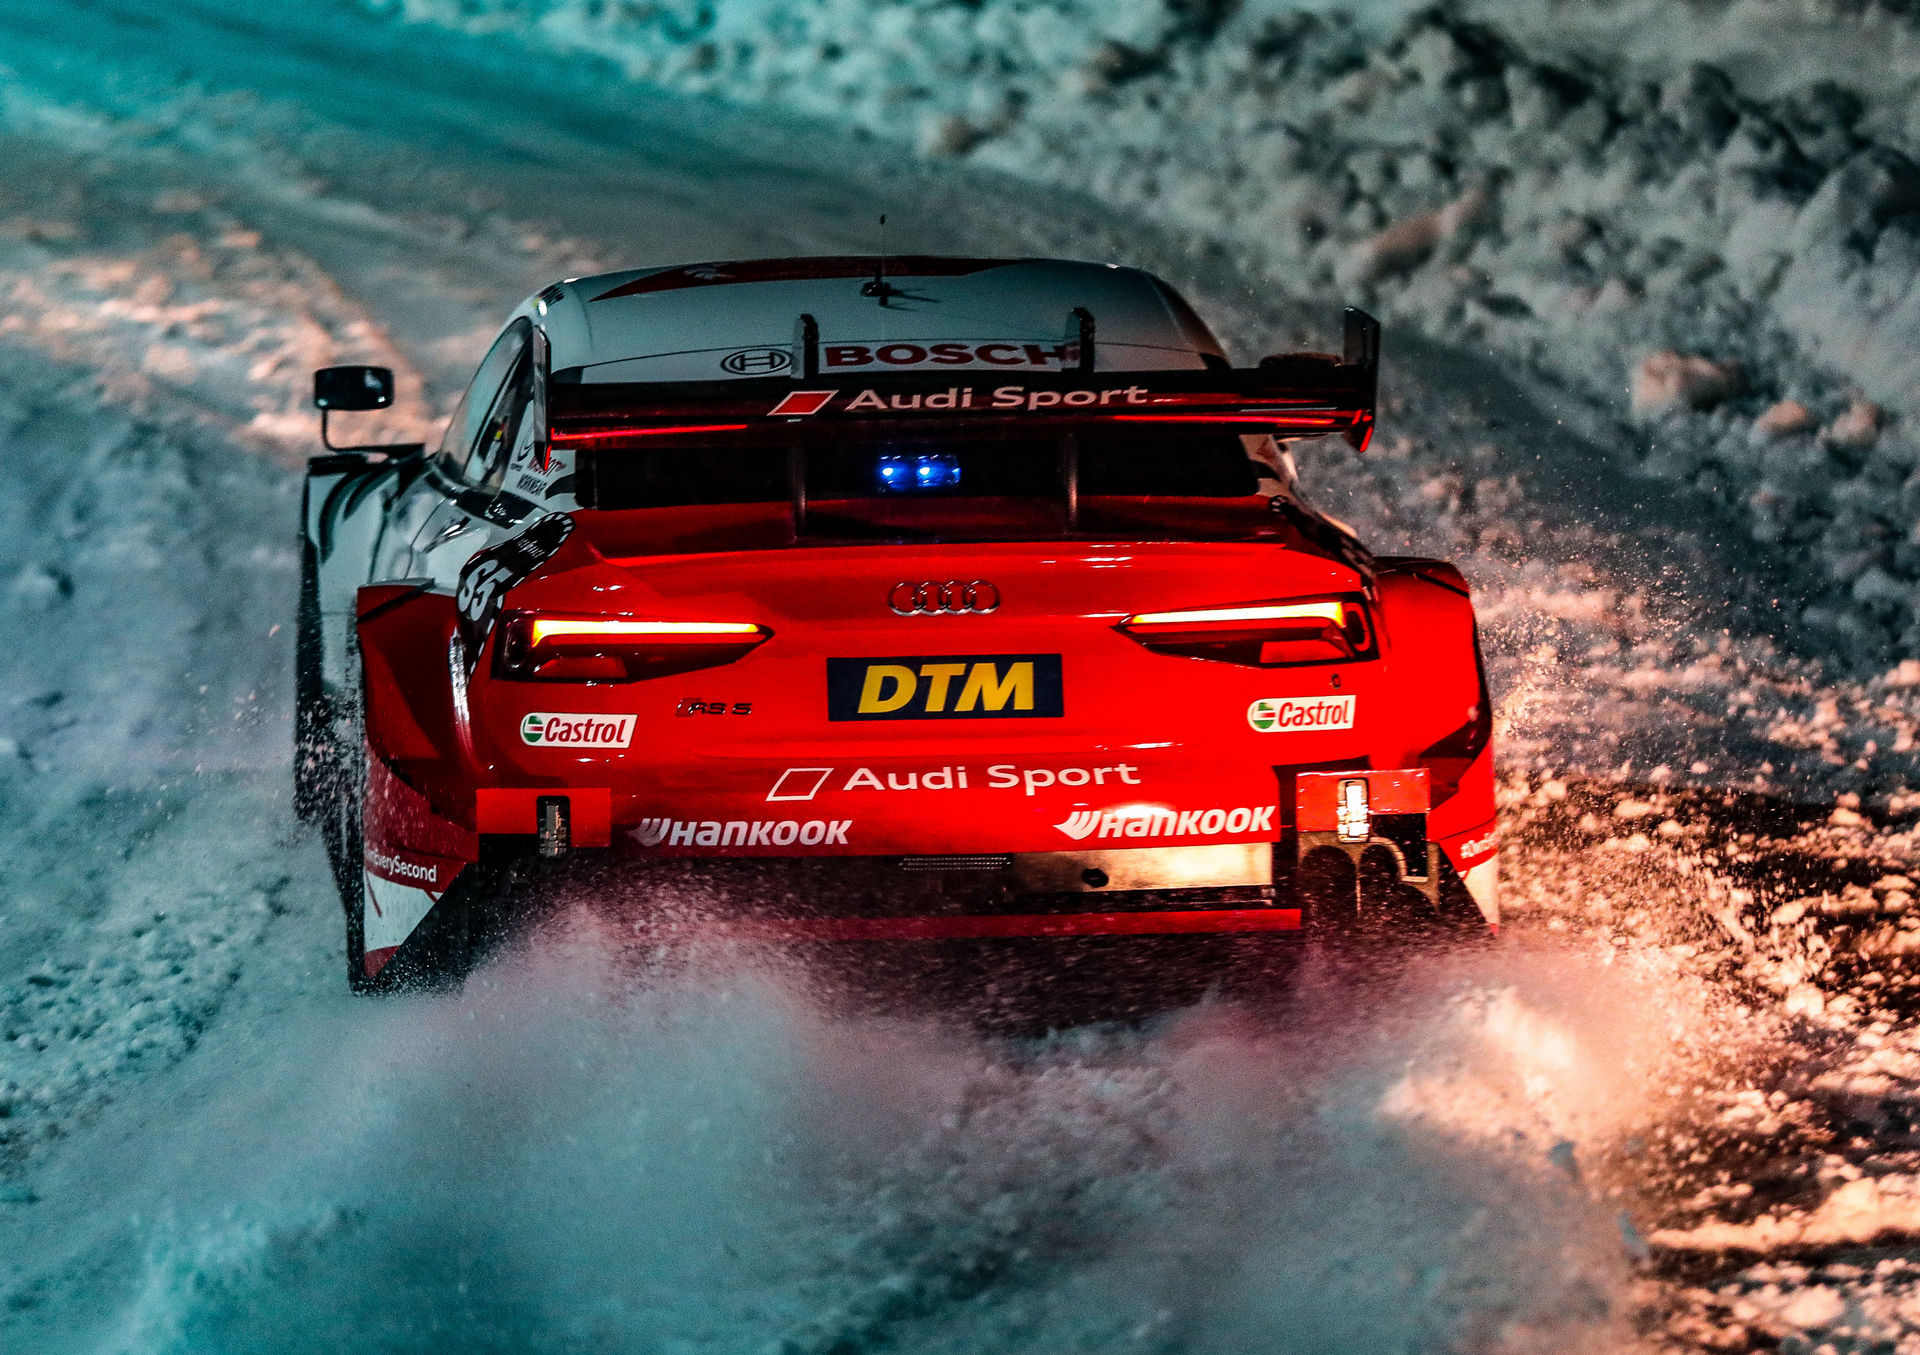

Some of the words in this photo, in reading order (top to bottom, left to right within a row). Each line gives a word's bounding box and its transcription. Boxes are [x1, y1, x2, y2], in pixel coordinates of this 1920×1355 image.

[825, 344, 1068, 368] BOSCH
[845, 388, 973, 411] Audi
[991, 385, 1149, 411] Sport
[857, 662, 1034, 713] DTM
[732, 703, 752, 715] 5
[1278, 701, 1350, 727] Castrol
[545, 717, 627, 743] Castrol
[843, 766, 968, 790] Audi
[987, 763, 1141, 796] Sport
